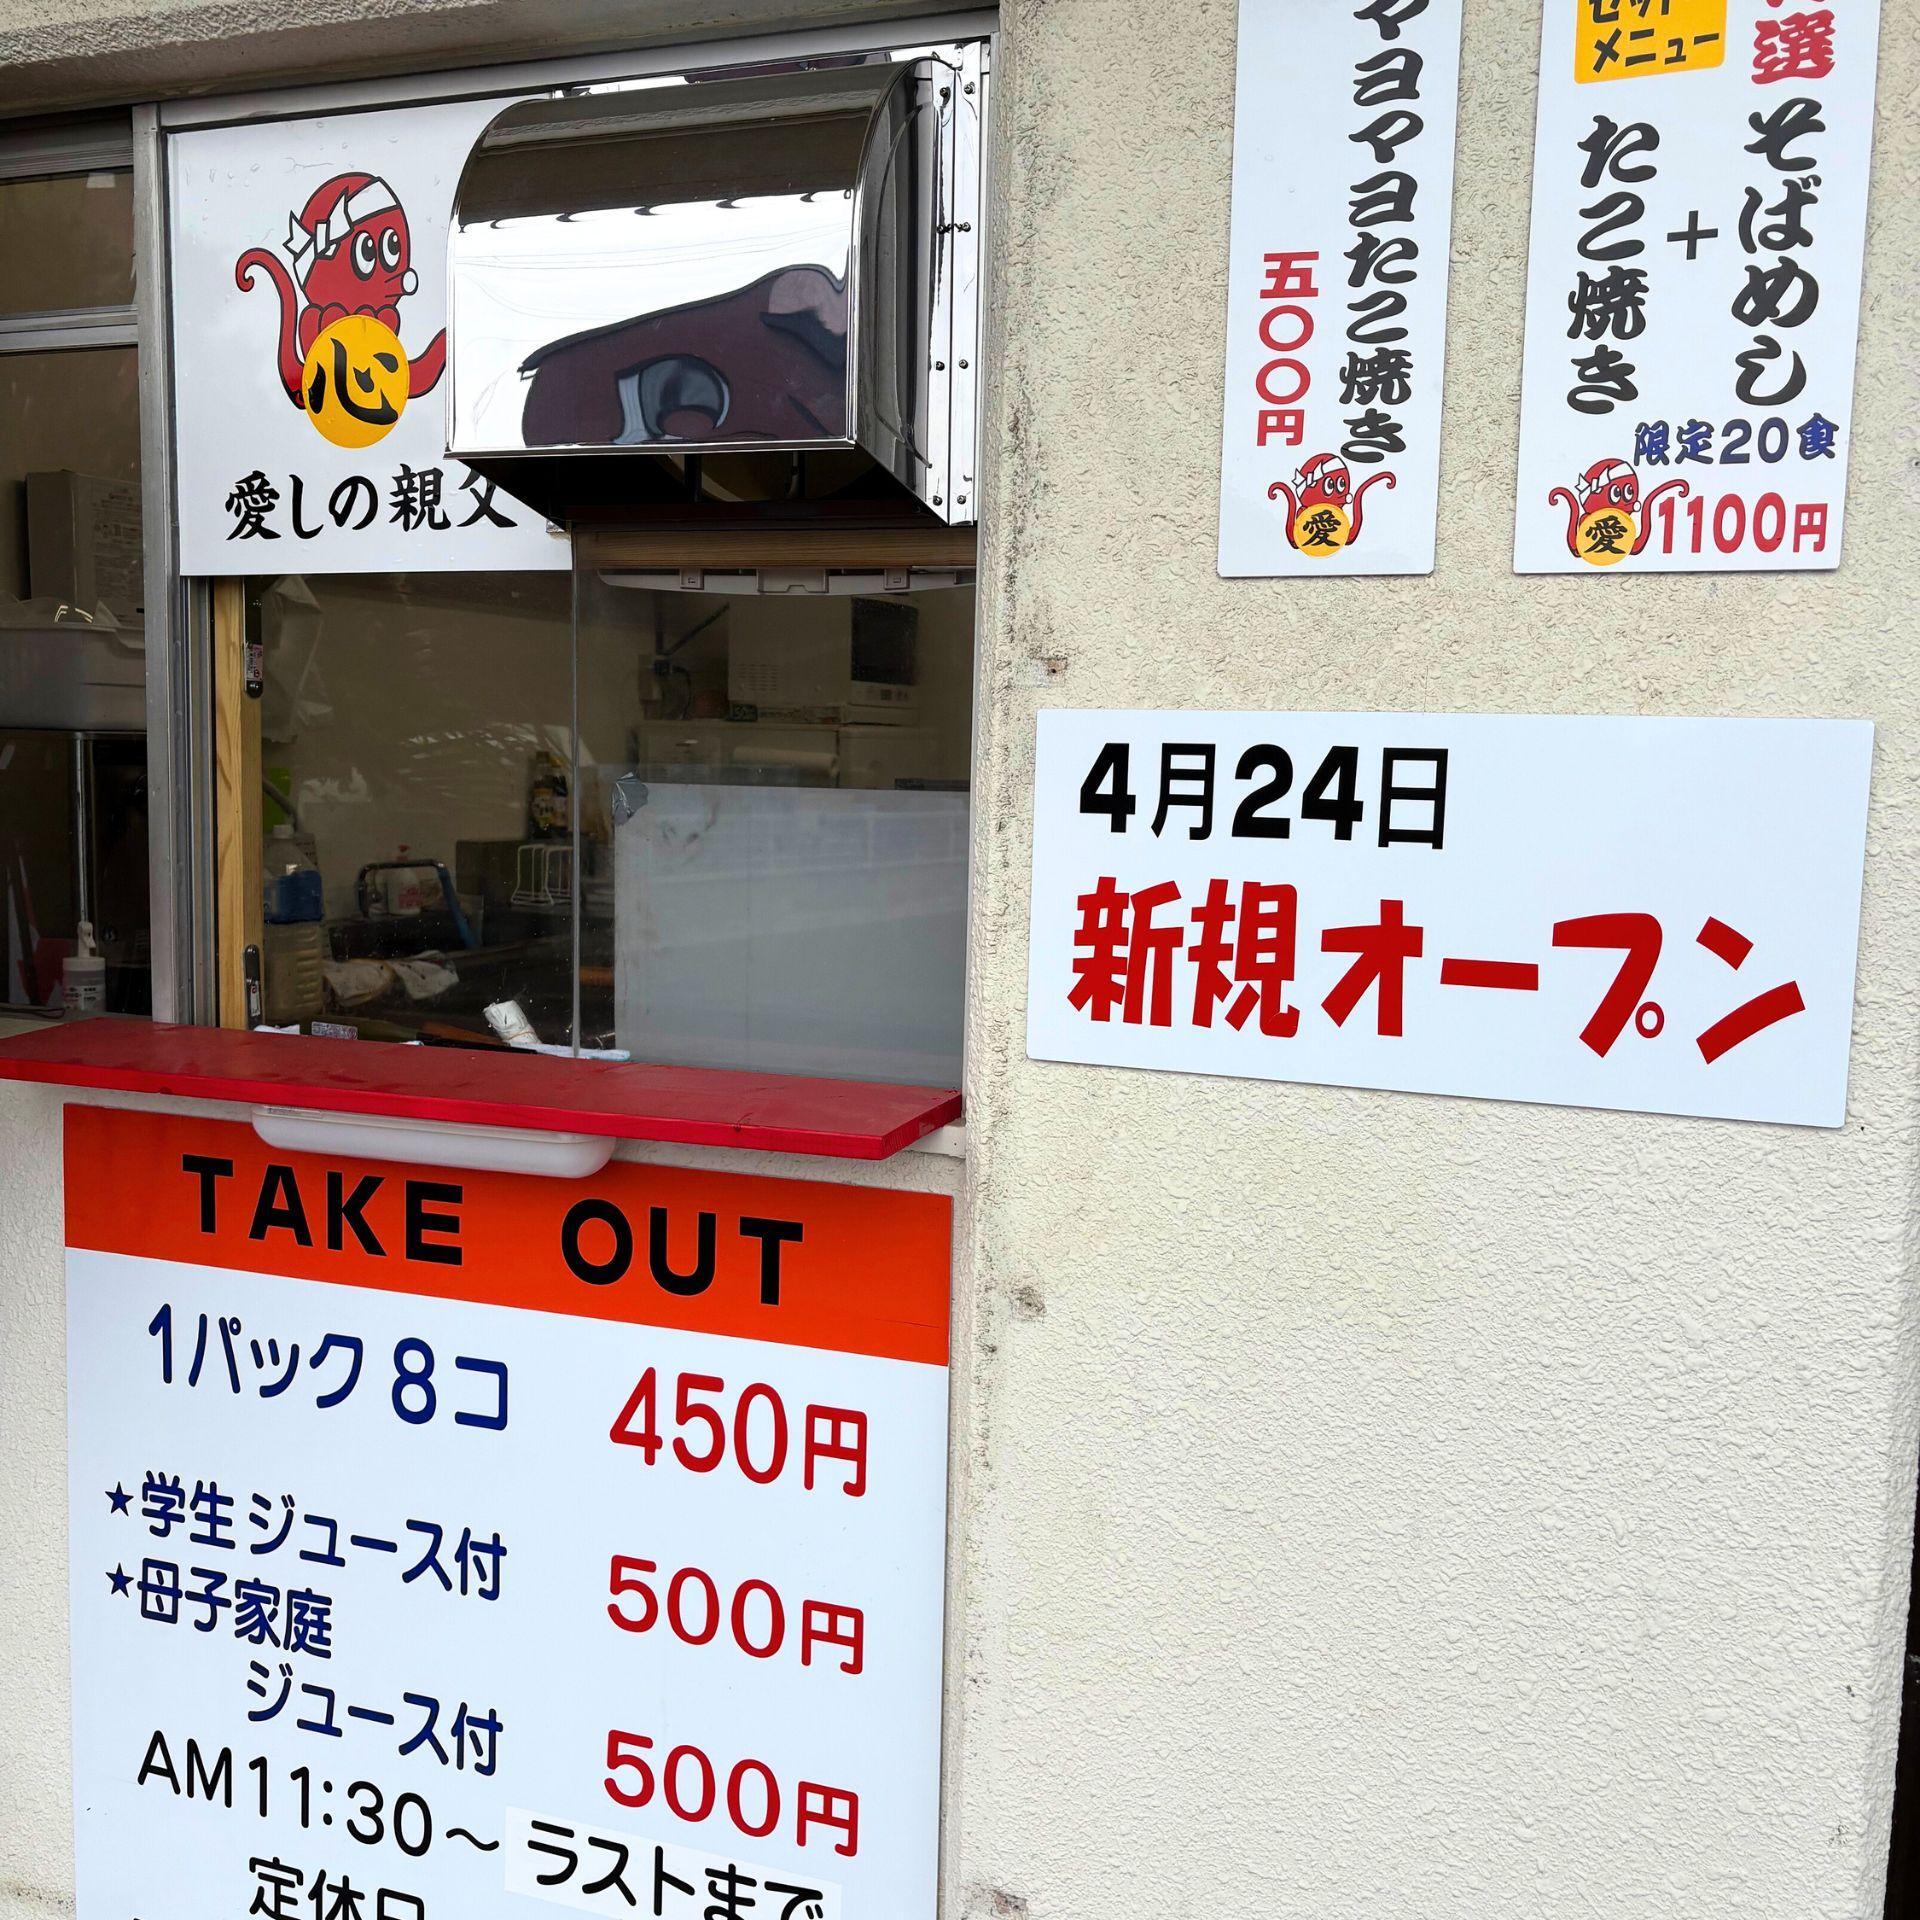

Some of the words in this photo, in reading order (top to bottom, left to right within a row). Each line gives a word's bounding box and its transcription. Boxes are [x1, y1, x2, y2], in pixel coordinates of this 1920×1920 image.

[1593, 28, 1719, 73] メニュー
[1339, 0, 1430, 462] マヨマヨたこ焼き
[1567, 115, 1660, 414] たこ焼き
[1731, 97, 1826, 405] そばめし
[307, 337, 399, 426] 心
[1633, 413, 1840, 466] 限定20食
[225, 463, 518, 541] 愛しの親父
[1302, 509, 1342, 548] 愛
[1583, 511, 1627, 555] 愛
[1657, 492, 1828, 554] 1100円
[1080, 742, 1449, 850] 4月24日
[1067, 876, 1805, 1064] 新規オープン
[182, 1153, 464, 1266] TAKE
[561, 1199, 804, 1306] OUT
[148, 1303, 364, 1409] 1パック
[609, 1366, 868, 1498] 450円
[138, 1557, 333, 1659] 母子家庭
[607, 1554, 865, 1674] 500円
[247, 1660, 504, 1776] ジュース付
[603, 1729, 859, 1857] 500円
[527, 1819, 825, 1920] ラストまで
